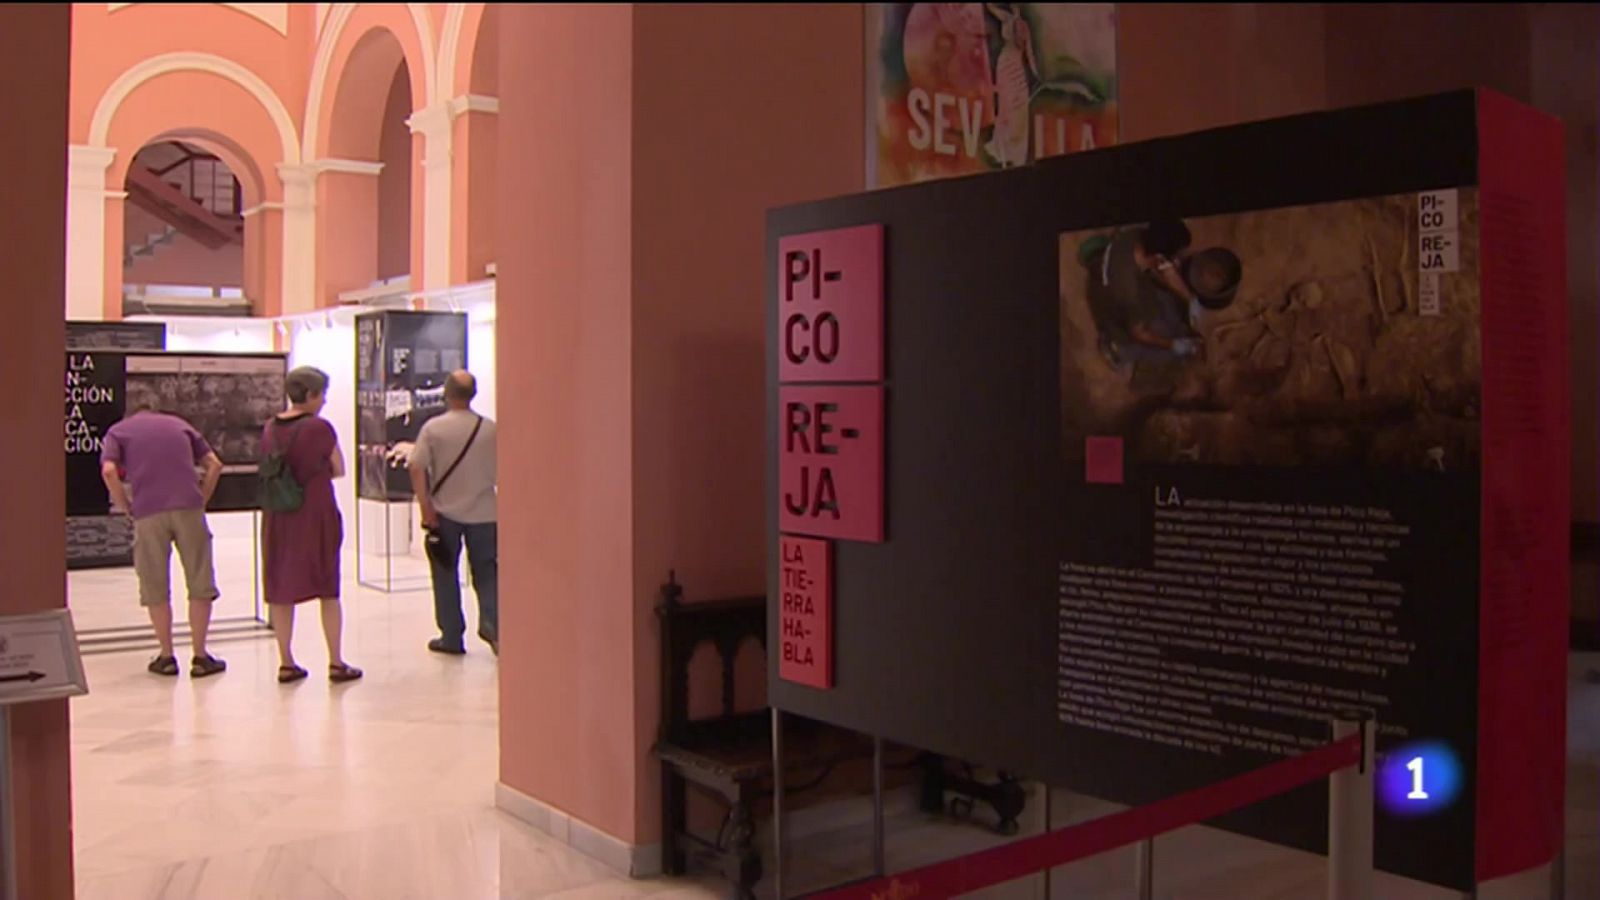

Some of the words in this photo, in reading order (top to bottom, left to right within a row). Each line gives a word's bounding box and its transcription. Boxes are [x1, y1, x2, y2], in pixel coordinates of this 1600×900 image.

[1421, 195, 1444, 210] PI-
[1421, 212, 1443, 228] CO
[1421, 236, 1451, 252] RE-
[1421, 254, 1444, 269] JA
[785, 248, 842, 302] PI-
[785, 311, 839, 365] CO
[70, 354, 94, 371] LA
[786, 402, 860, 455] RE-
[785, 466, 841, 521] JA
[1155, 486, 1181, 506] LA
[783, 543, 804, 563] LA
[784, 567, 814, 591] TIE-
[783, 592, 814, 615] RRA
[783, 617, 811, 639] HA-
[783, 641, 814, 667] BLA
